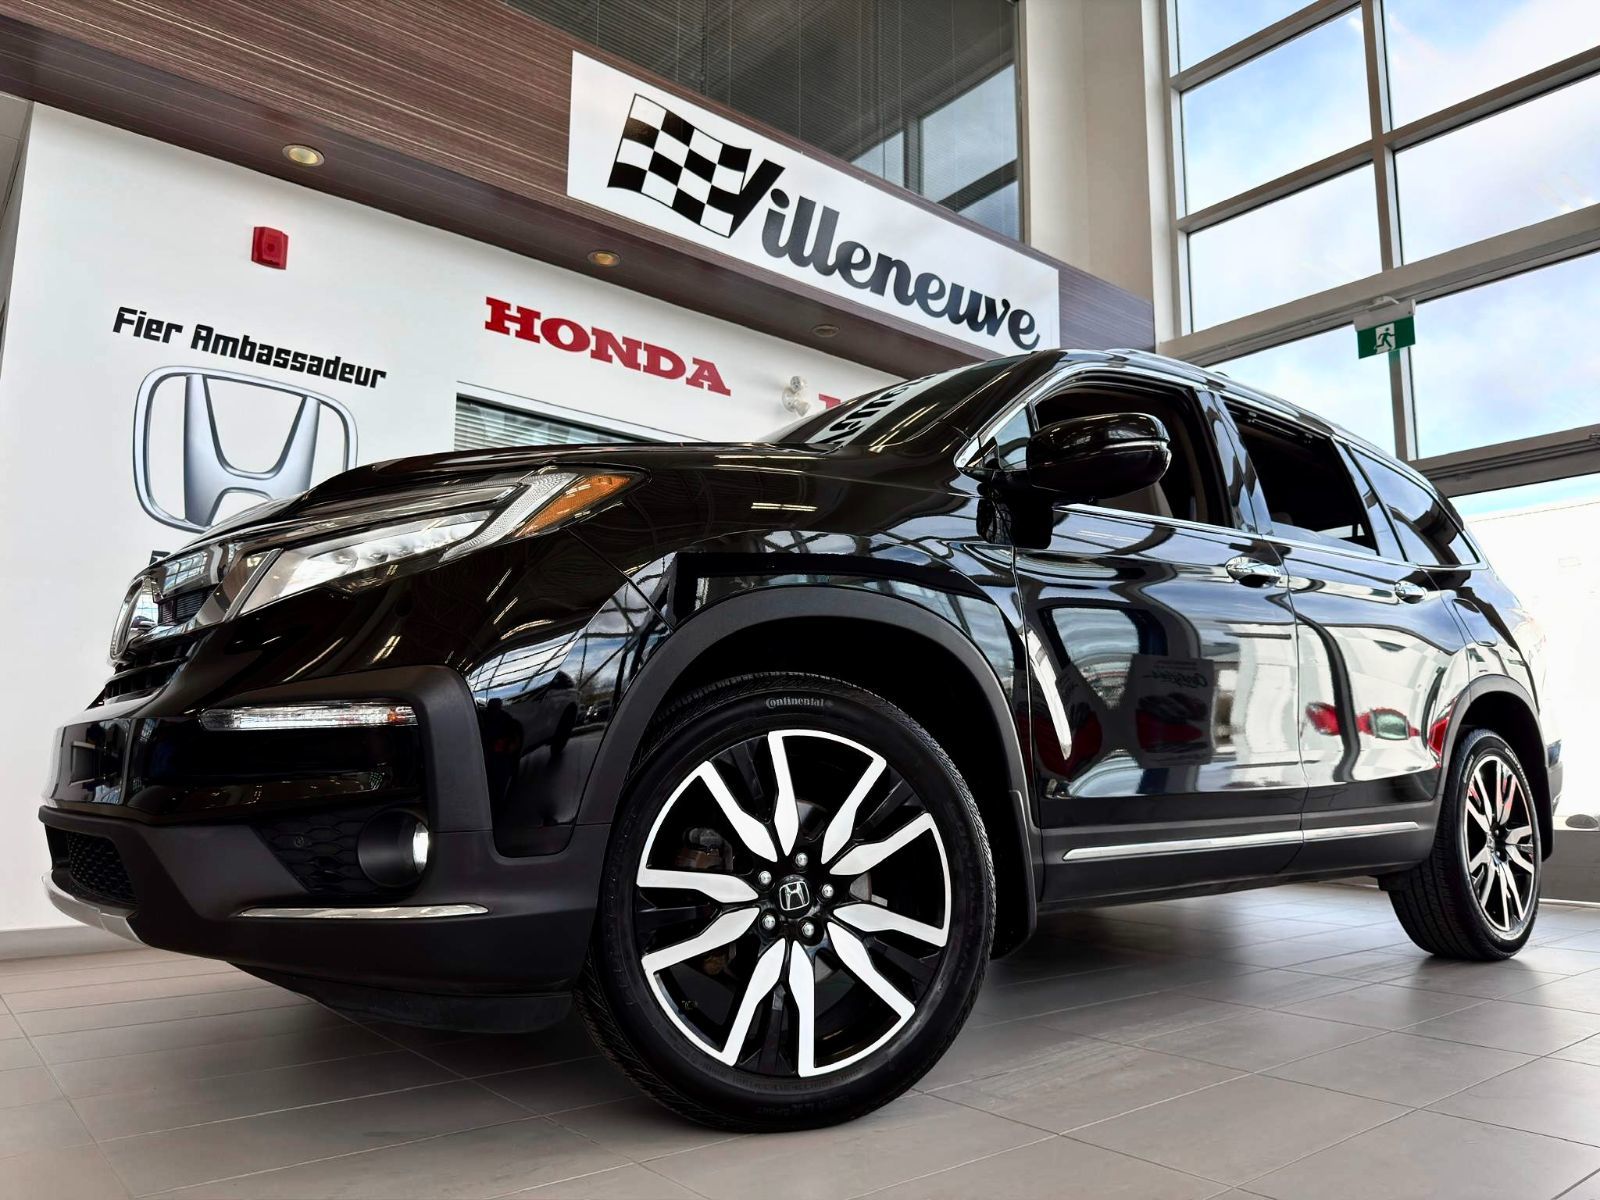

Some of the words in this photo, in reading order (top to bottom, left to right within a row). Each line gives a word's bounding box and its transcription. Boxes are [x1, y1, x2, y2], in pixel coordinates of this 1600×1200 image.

[724, 148, 1041, 350] Villeneuve
[112, 306, 183, 344] Fier
[190, 323, 387, 389] Ambassadeur
[484, 296, 732, 397] HONDA
[765, 696, 824, 709] Continental
